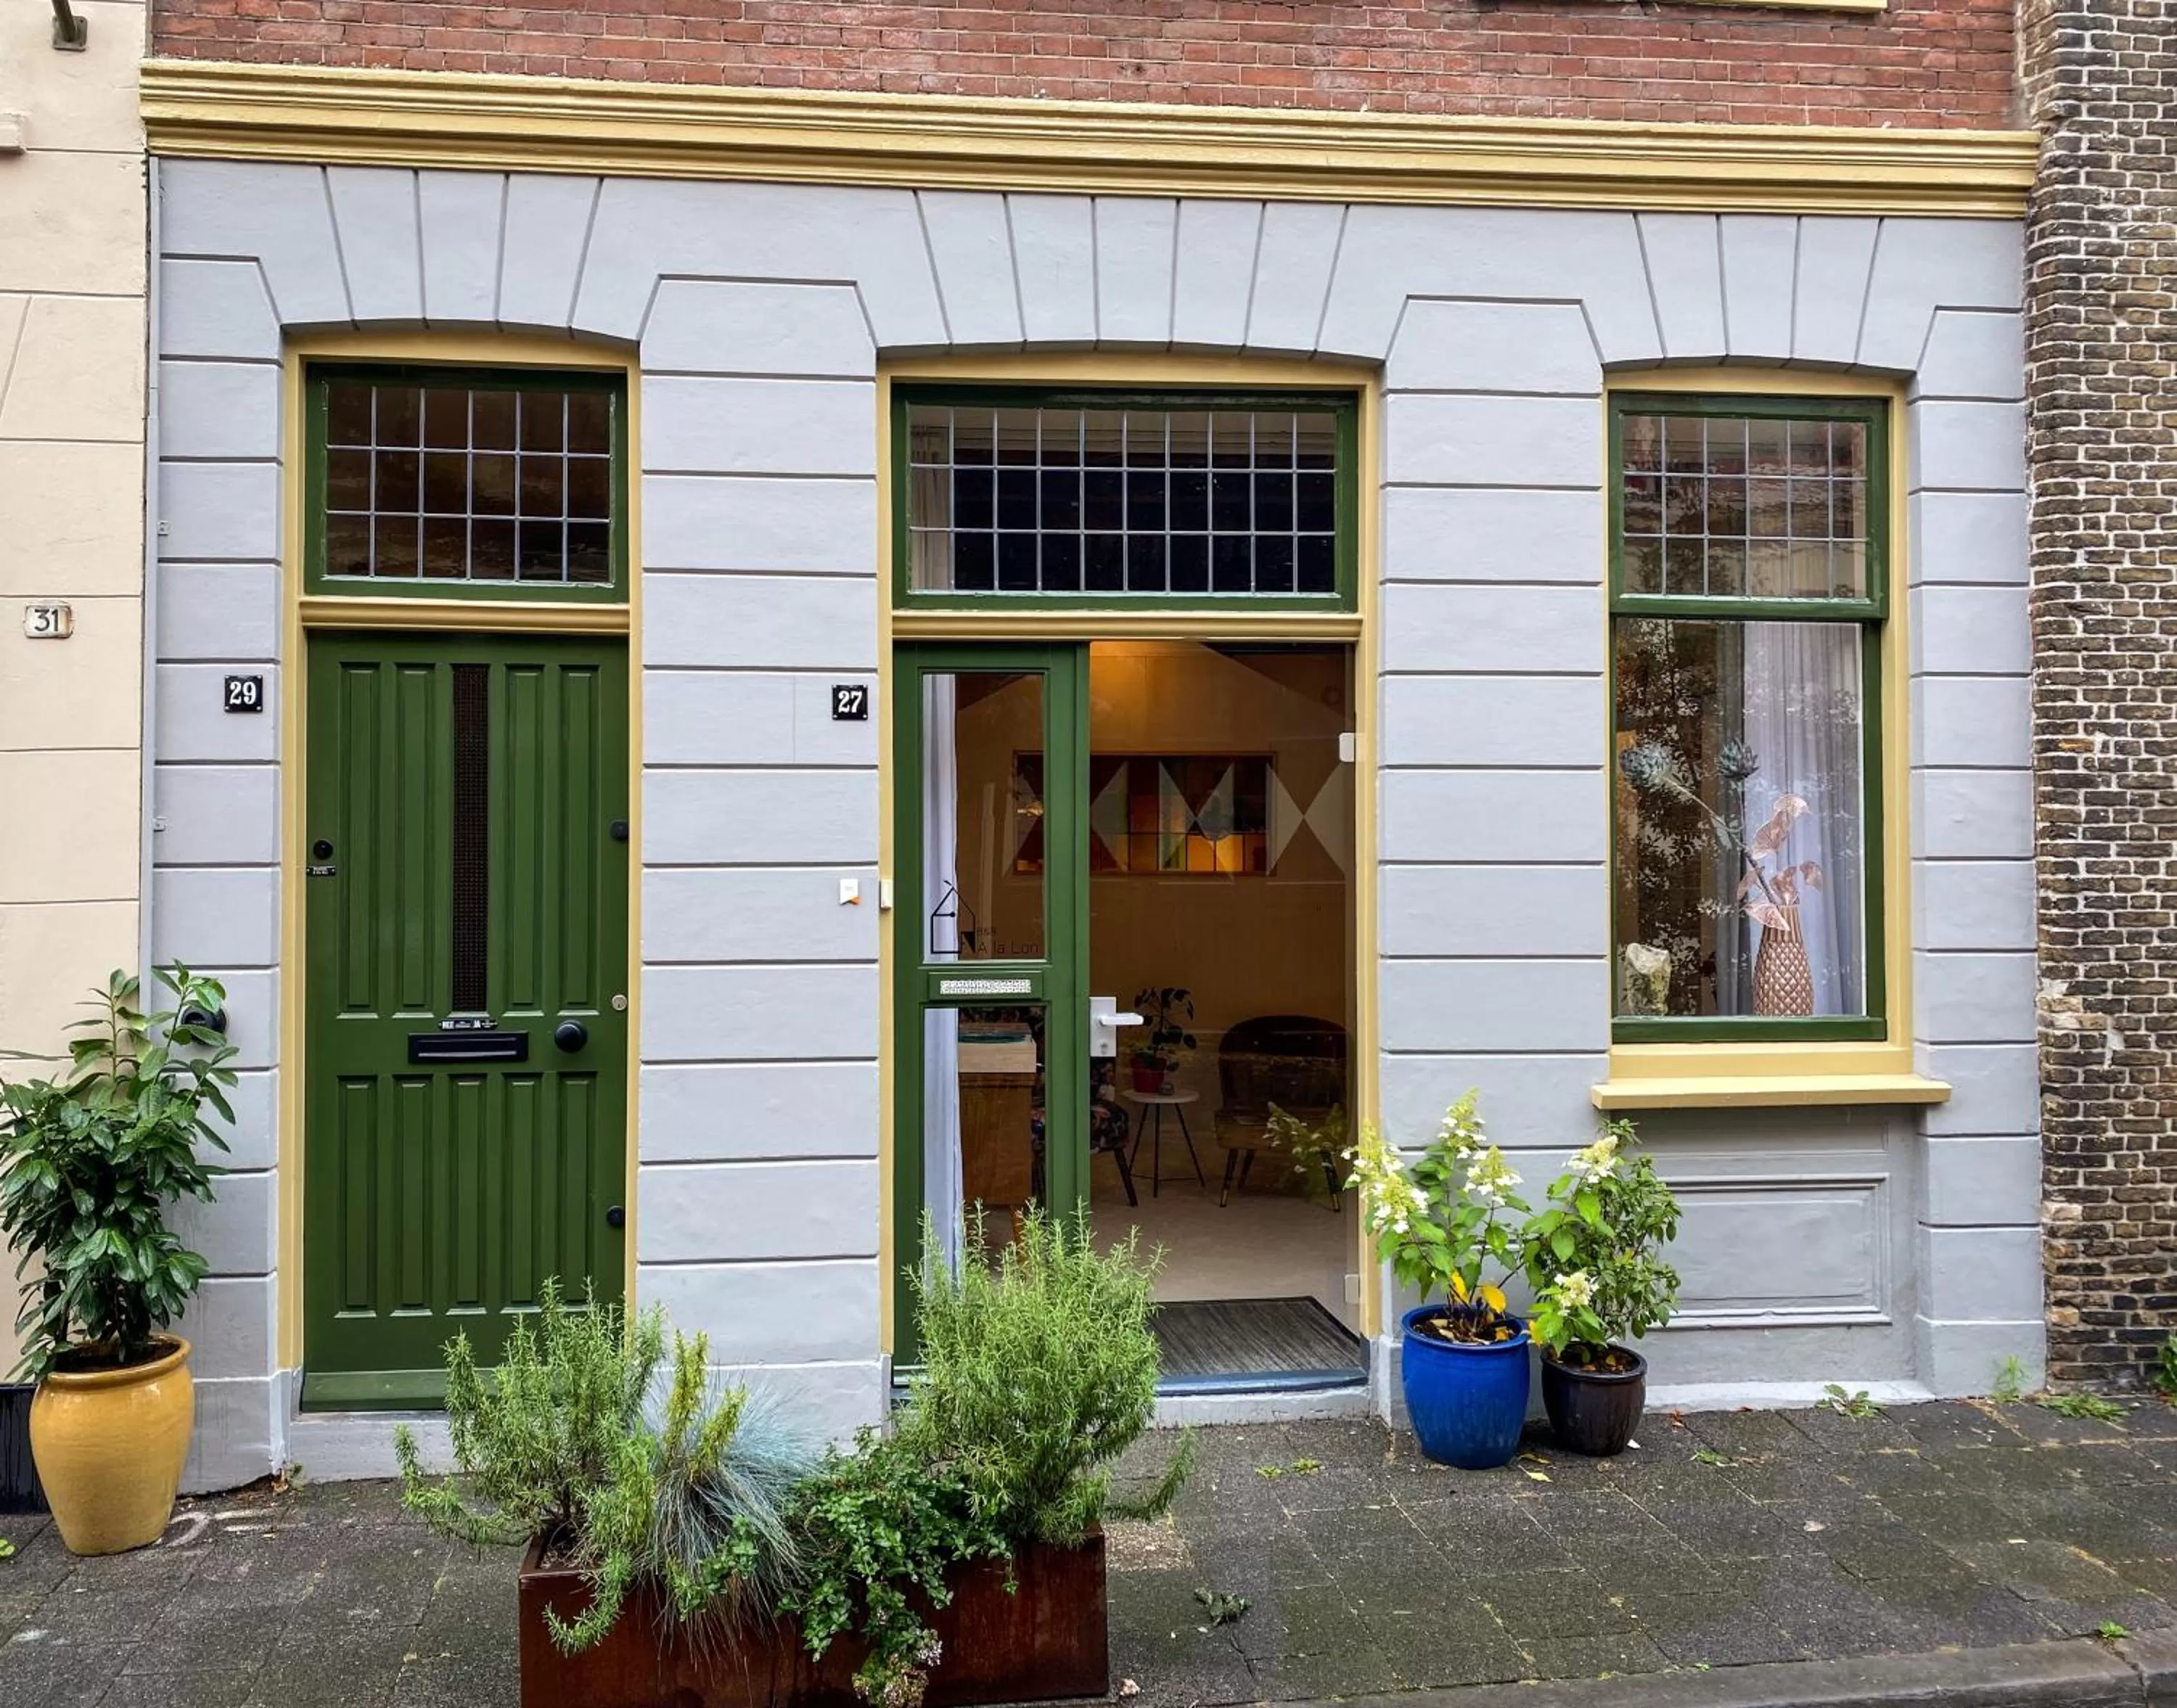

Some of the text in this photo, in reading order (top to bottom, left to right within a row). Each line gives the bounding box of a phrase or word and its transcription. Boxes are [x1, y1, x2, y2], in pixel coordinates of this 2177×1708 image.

[34, 608, 59, 632] 31
[229, 681, 256, 705] 29
[837, 690, 863, 713] 27
[993, 940, 1005, 954] la
[1010, 940, 1038, 955] Lon
